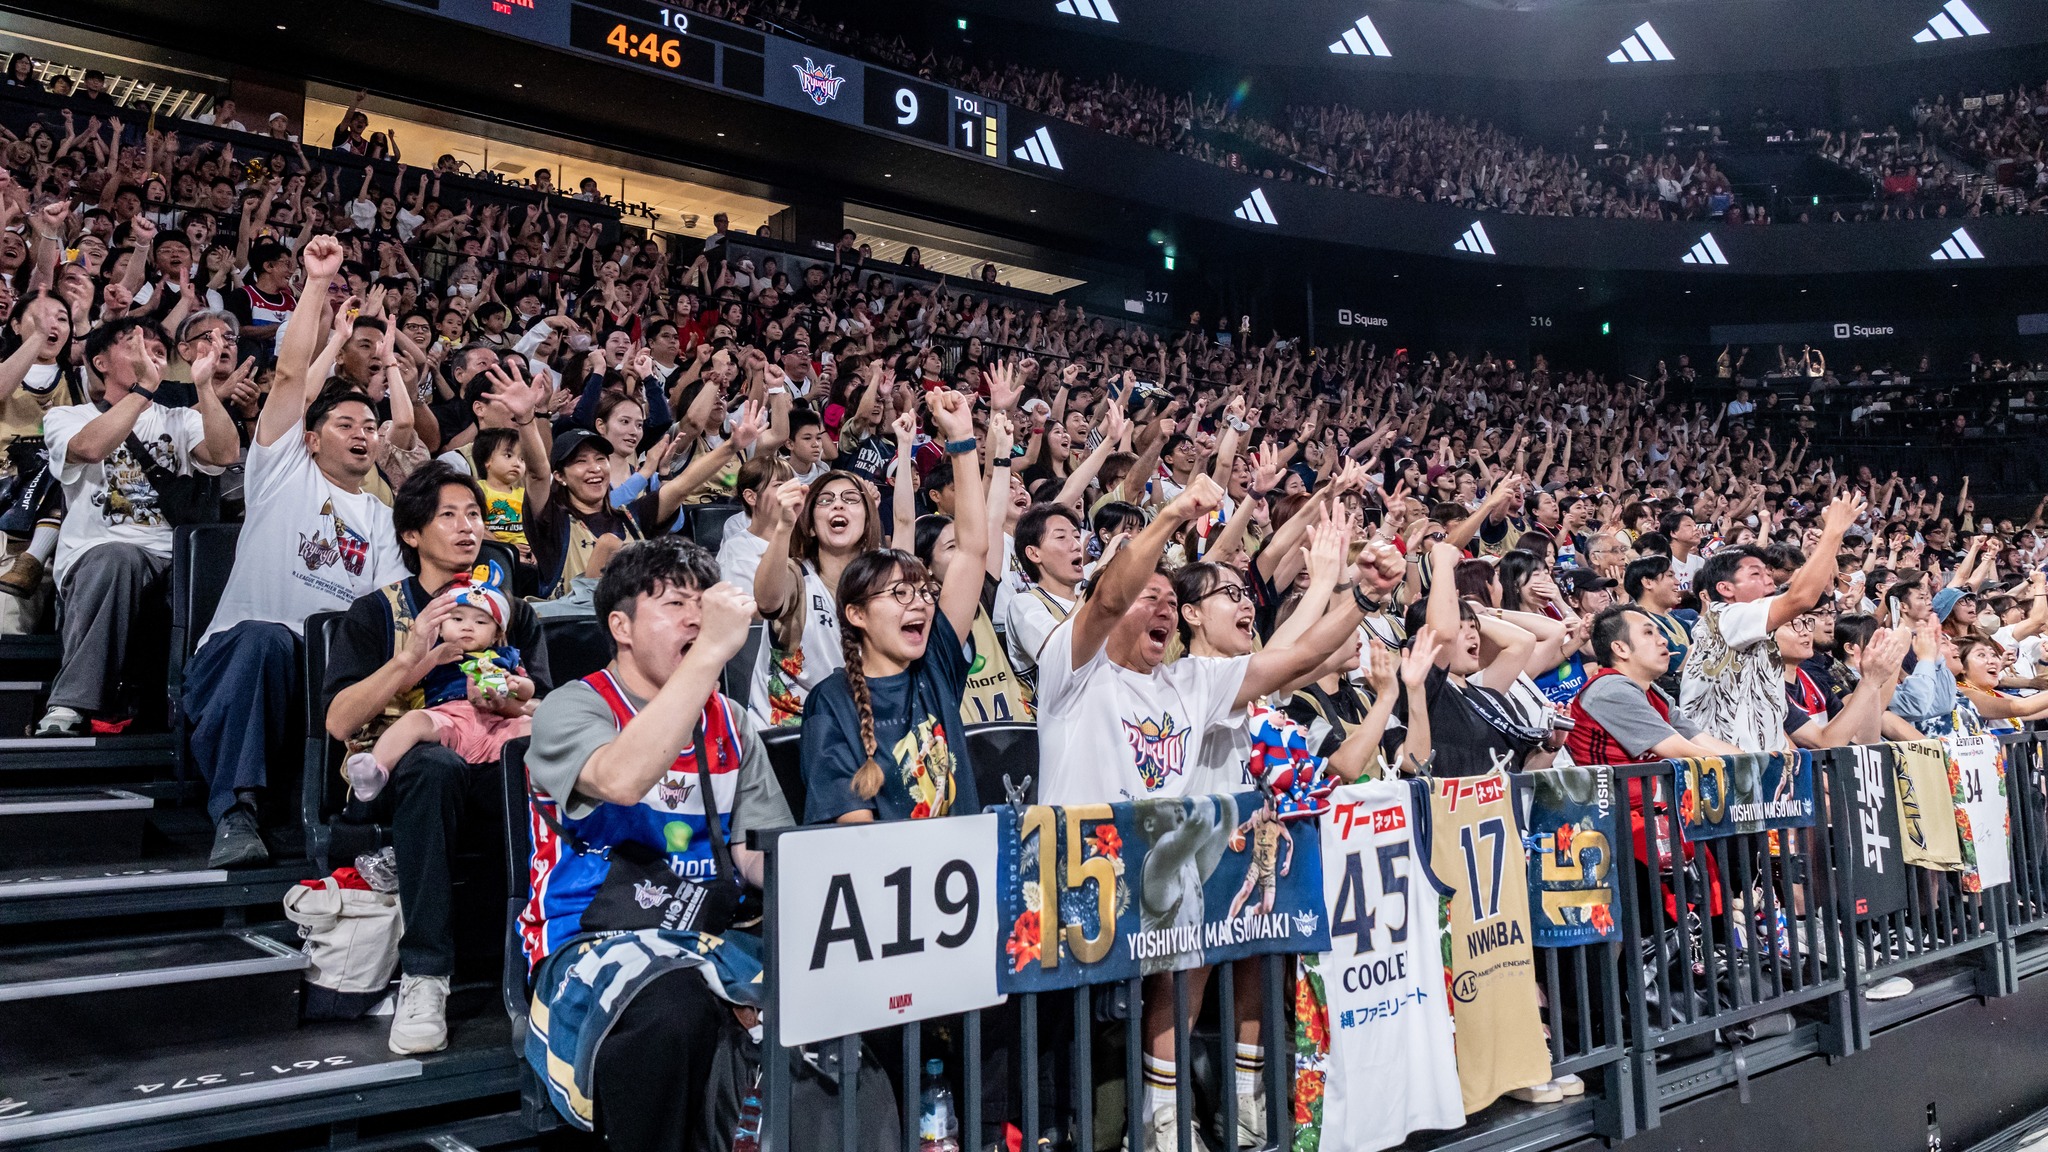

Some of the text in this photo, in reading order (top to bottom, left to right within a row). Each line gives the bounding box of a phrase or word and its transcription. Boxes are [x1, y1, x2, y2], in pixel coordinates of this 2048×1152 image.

[660, 9, 688, 34] 1Q
[606, 24, 681, 68] 4:46
[895, 88, 918, 125] 9
[955, 96, 982, 115] TOL
[961, 120, 973, 147] 1
[1146, 291, 1169, 303] 317
[1354, 313, 1388, 327] Square
[1530, 316, 1552, 327] 316
[1853, 325, 1894, 338] Square
[315, 580, 337, 593] PREMIER
[972, 691, 1014, 721] 14
[1965, 769, 1983, 804] 34
[1460, 816, 1507, 924] 17
[1541, 829, 1613, 926] 15
[1009, 864, 1017, 922] GOLDEN
[1020, 804, 1117, 969] 15
[1331, 840, 1411, 956] 45
[808, 858, 981, 972] A19
[1127, 925, 1201, 960] YOSHIYUKI
[1204, 912, 1290, 948] MATSUWAKI
[1467, 920, 1525, 960] NWABA
[1343, 950, 1408, 993] COOLE
[1502, 958, 1531, 968] ENGINE
[889, 992, 913, 1011] ALVARK
[271, 1055, 353, 1074] 361
[133, 1073, 228, 1094] 374
